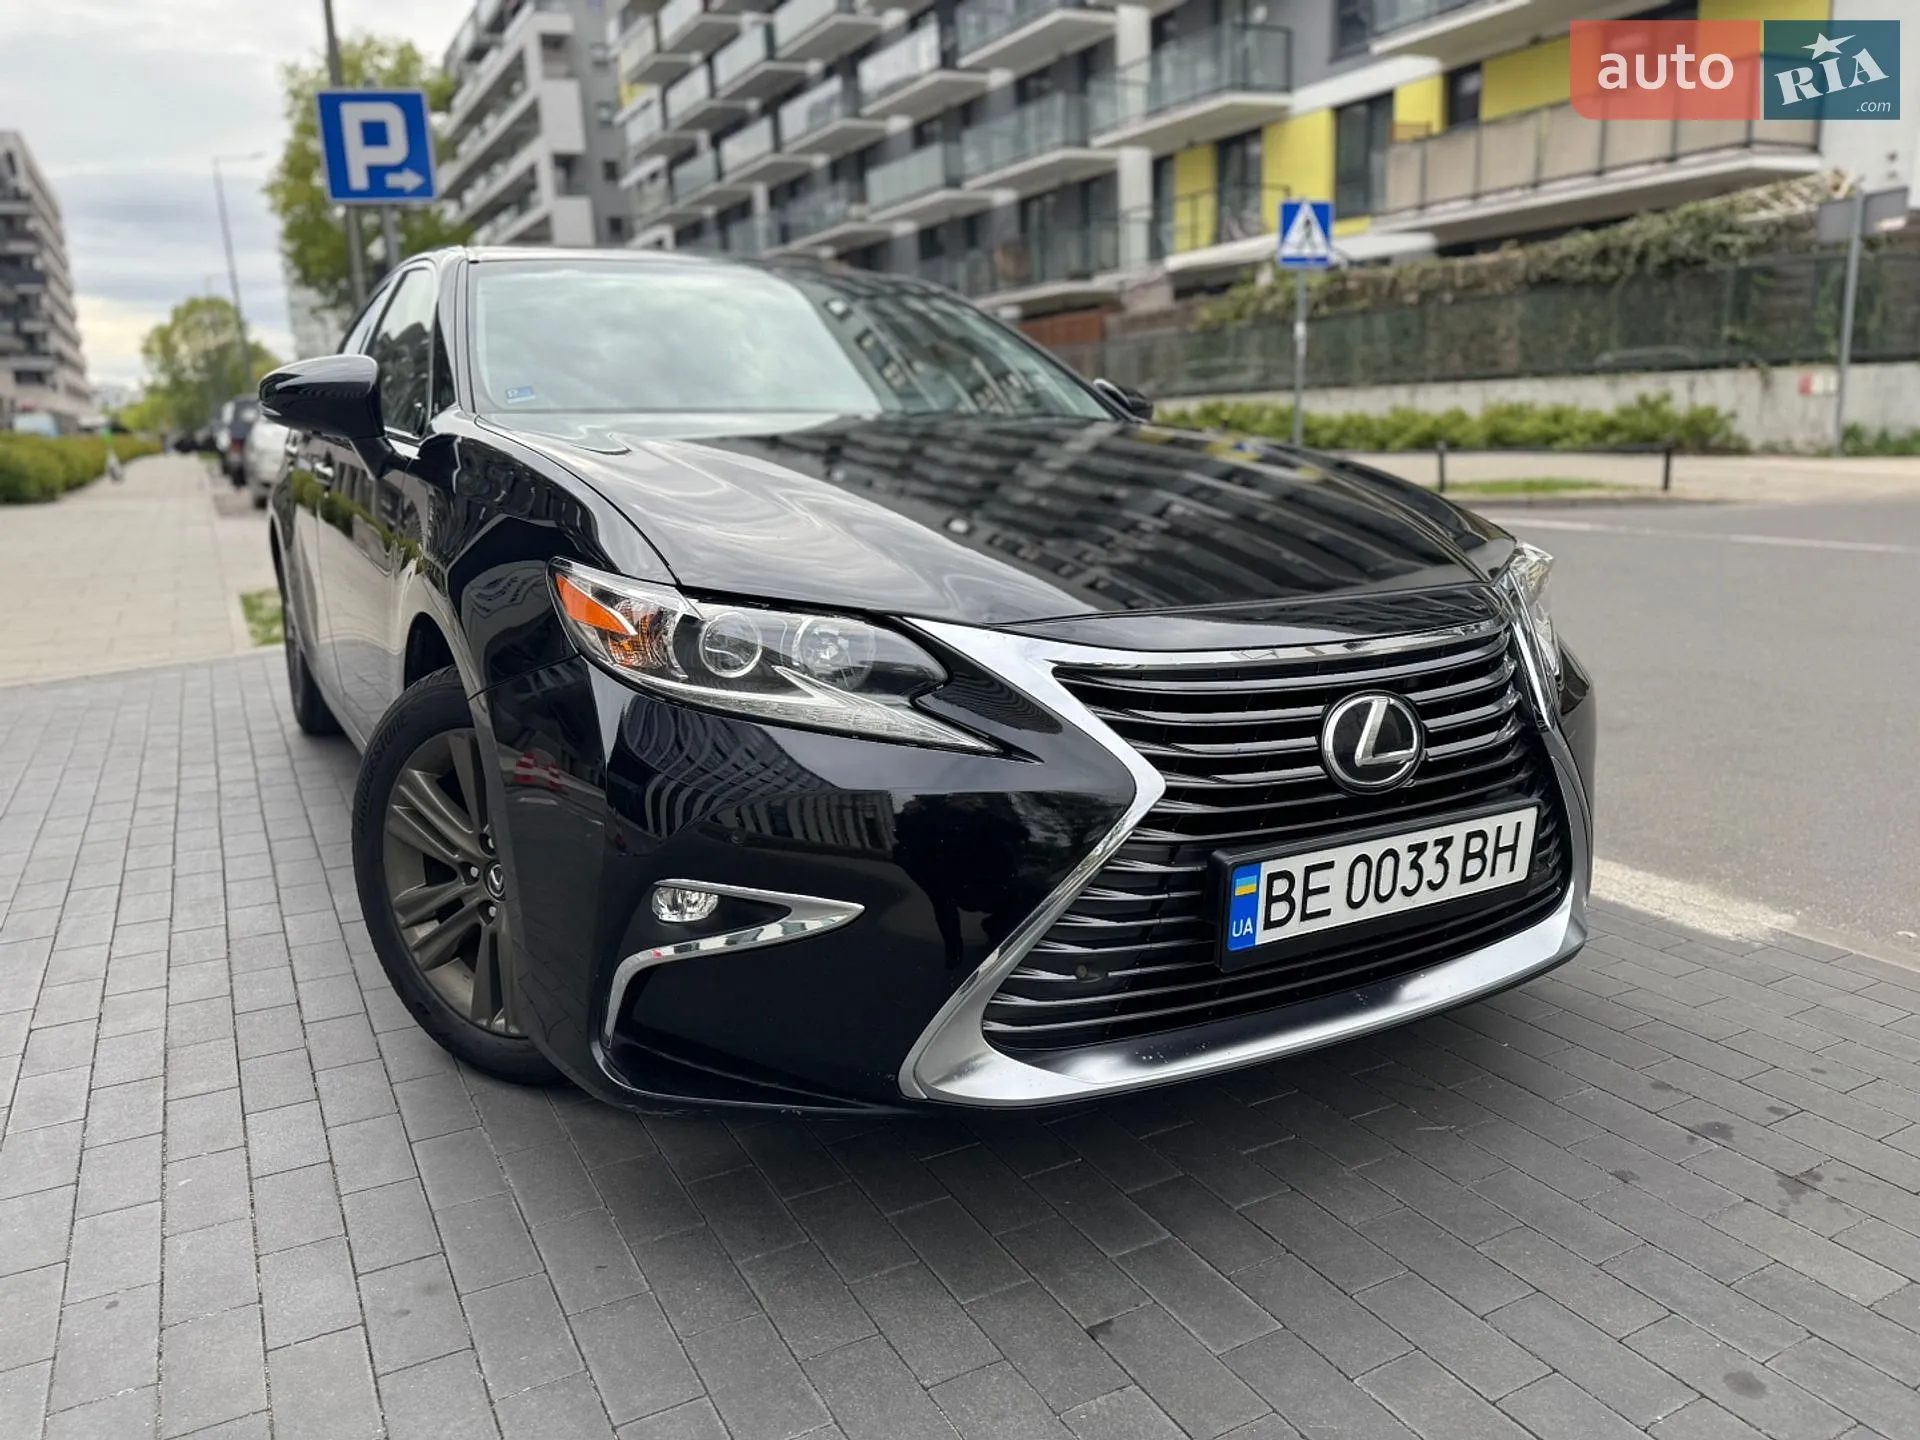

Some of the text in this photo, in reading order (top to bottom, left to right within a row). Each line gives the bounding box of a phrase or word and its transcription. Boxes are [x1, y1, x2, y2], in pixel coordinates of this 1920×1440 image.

[339, 101, 409, 191] P
[1262, 821, 1522, 931] BE 0033 BH
[1231, 918, 1254, 938] UA
